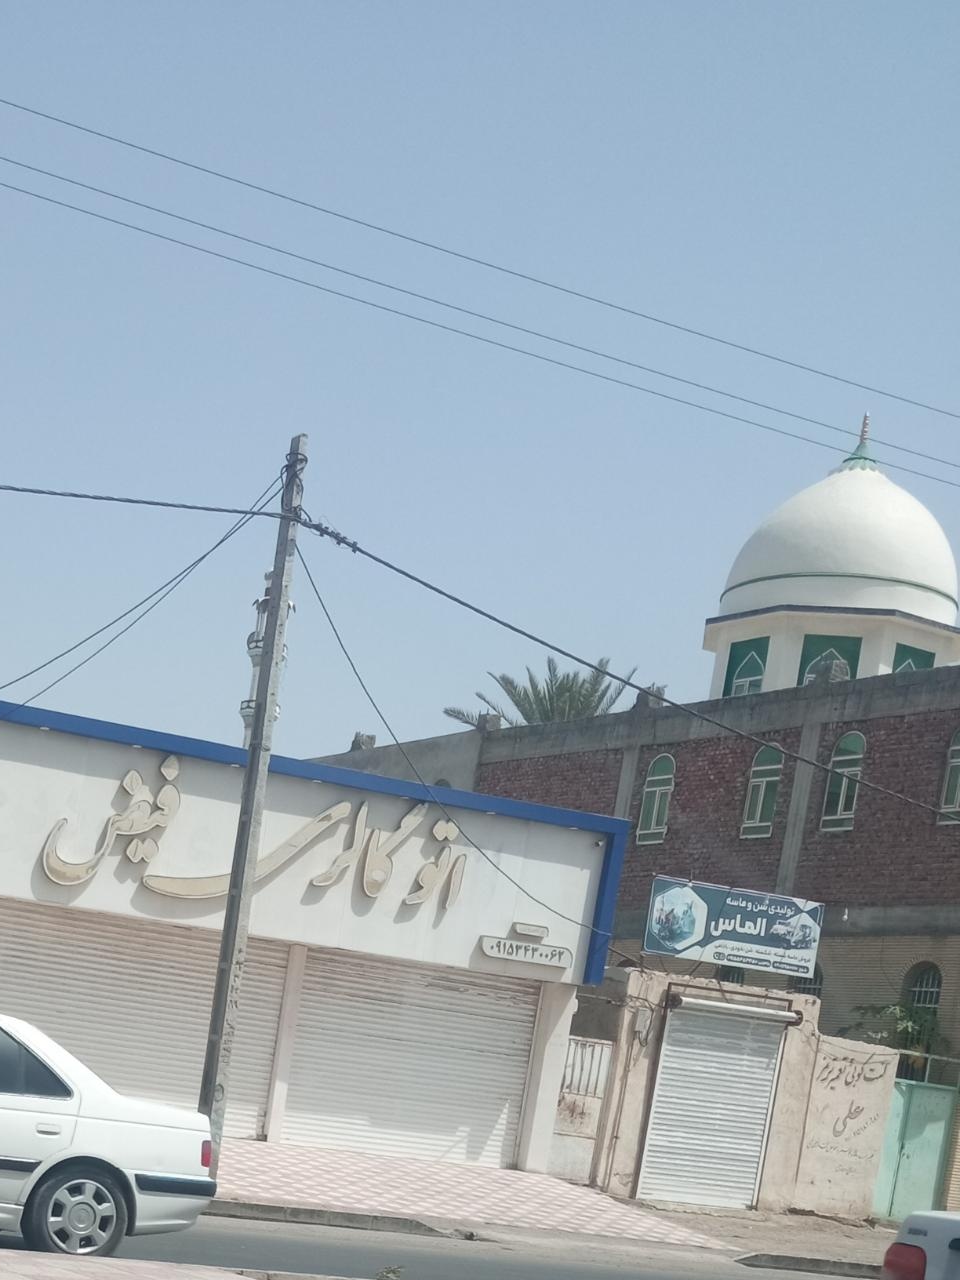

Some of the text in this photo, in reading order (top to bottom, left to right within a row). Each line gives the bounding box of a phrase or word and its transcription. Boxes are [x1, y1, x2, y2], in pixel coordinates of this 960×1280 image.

[41, 754, 467, 910] اتو گالری فیض
[726, 896, 747, 908] ماسه
[753, 899, 769, 912] شن
[768, 904, 796, 918] تولیدی
[709, 914, 767, 937] الماس
[832, 1099, 865, 1138] علی
